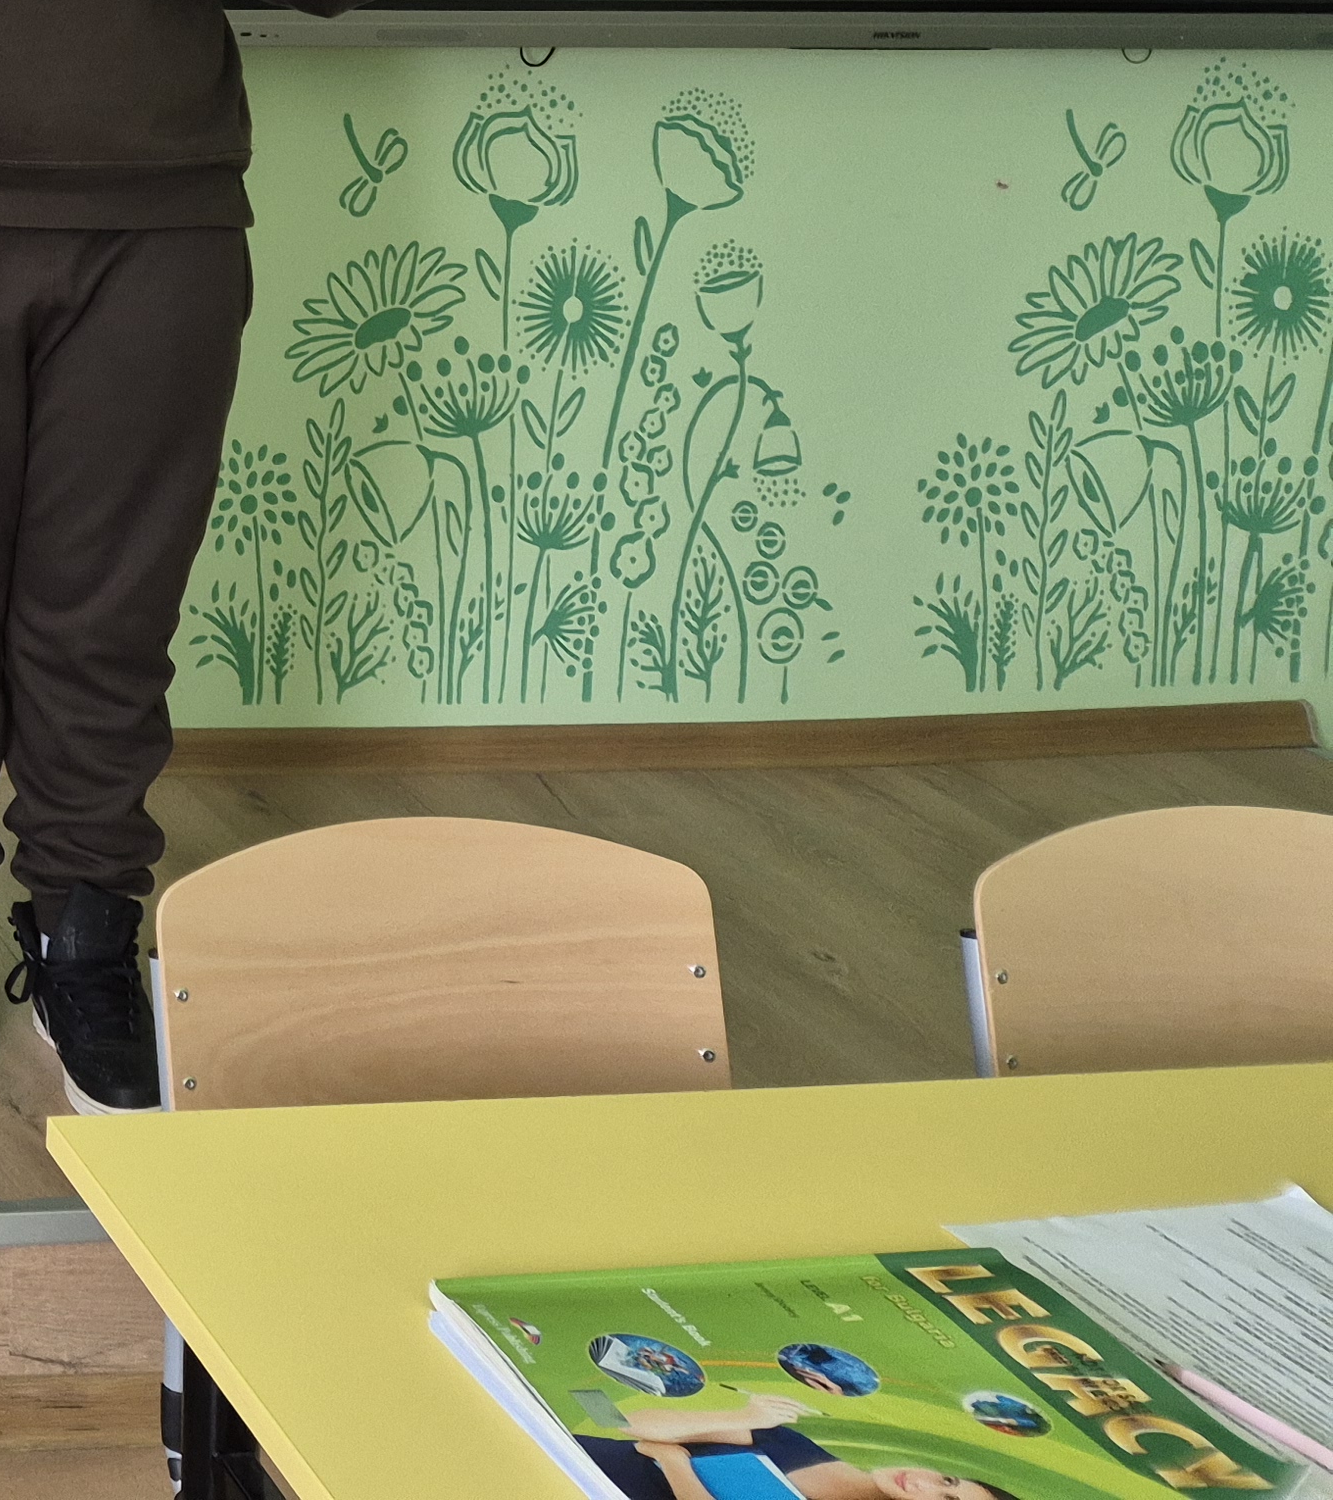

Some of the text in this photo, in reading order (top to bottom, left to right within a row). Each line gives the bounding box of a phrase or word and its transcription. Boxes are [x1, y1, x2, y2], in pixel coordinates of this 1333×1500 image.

[860, 1275, 956, 1349] for Bulgaria
[905, 1263, 1275, 1489] LEGACY
